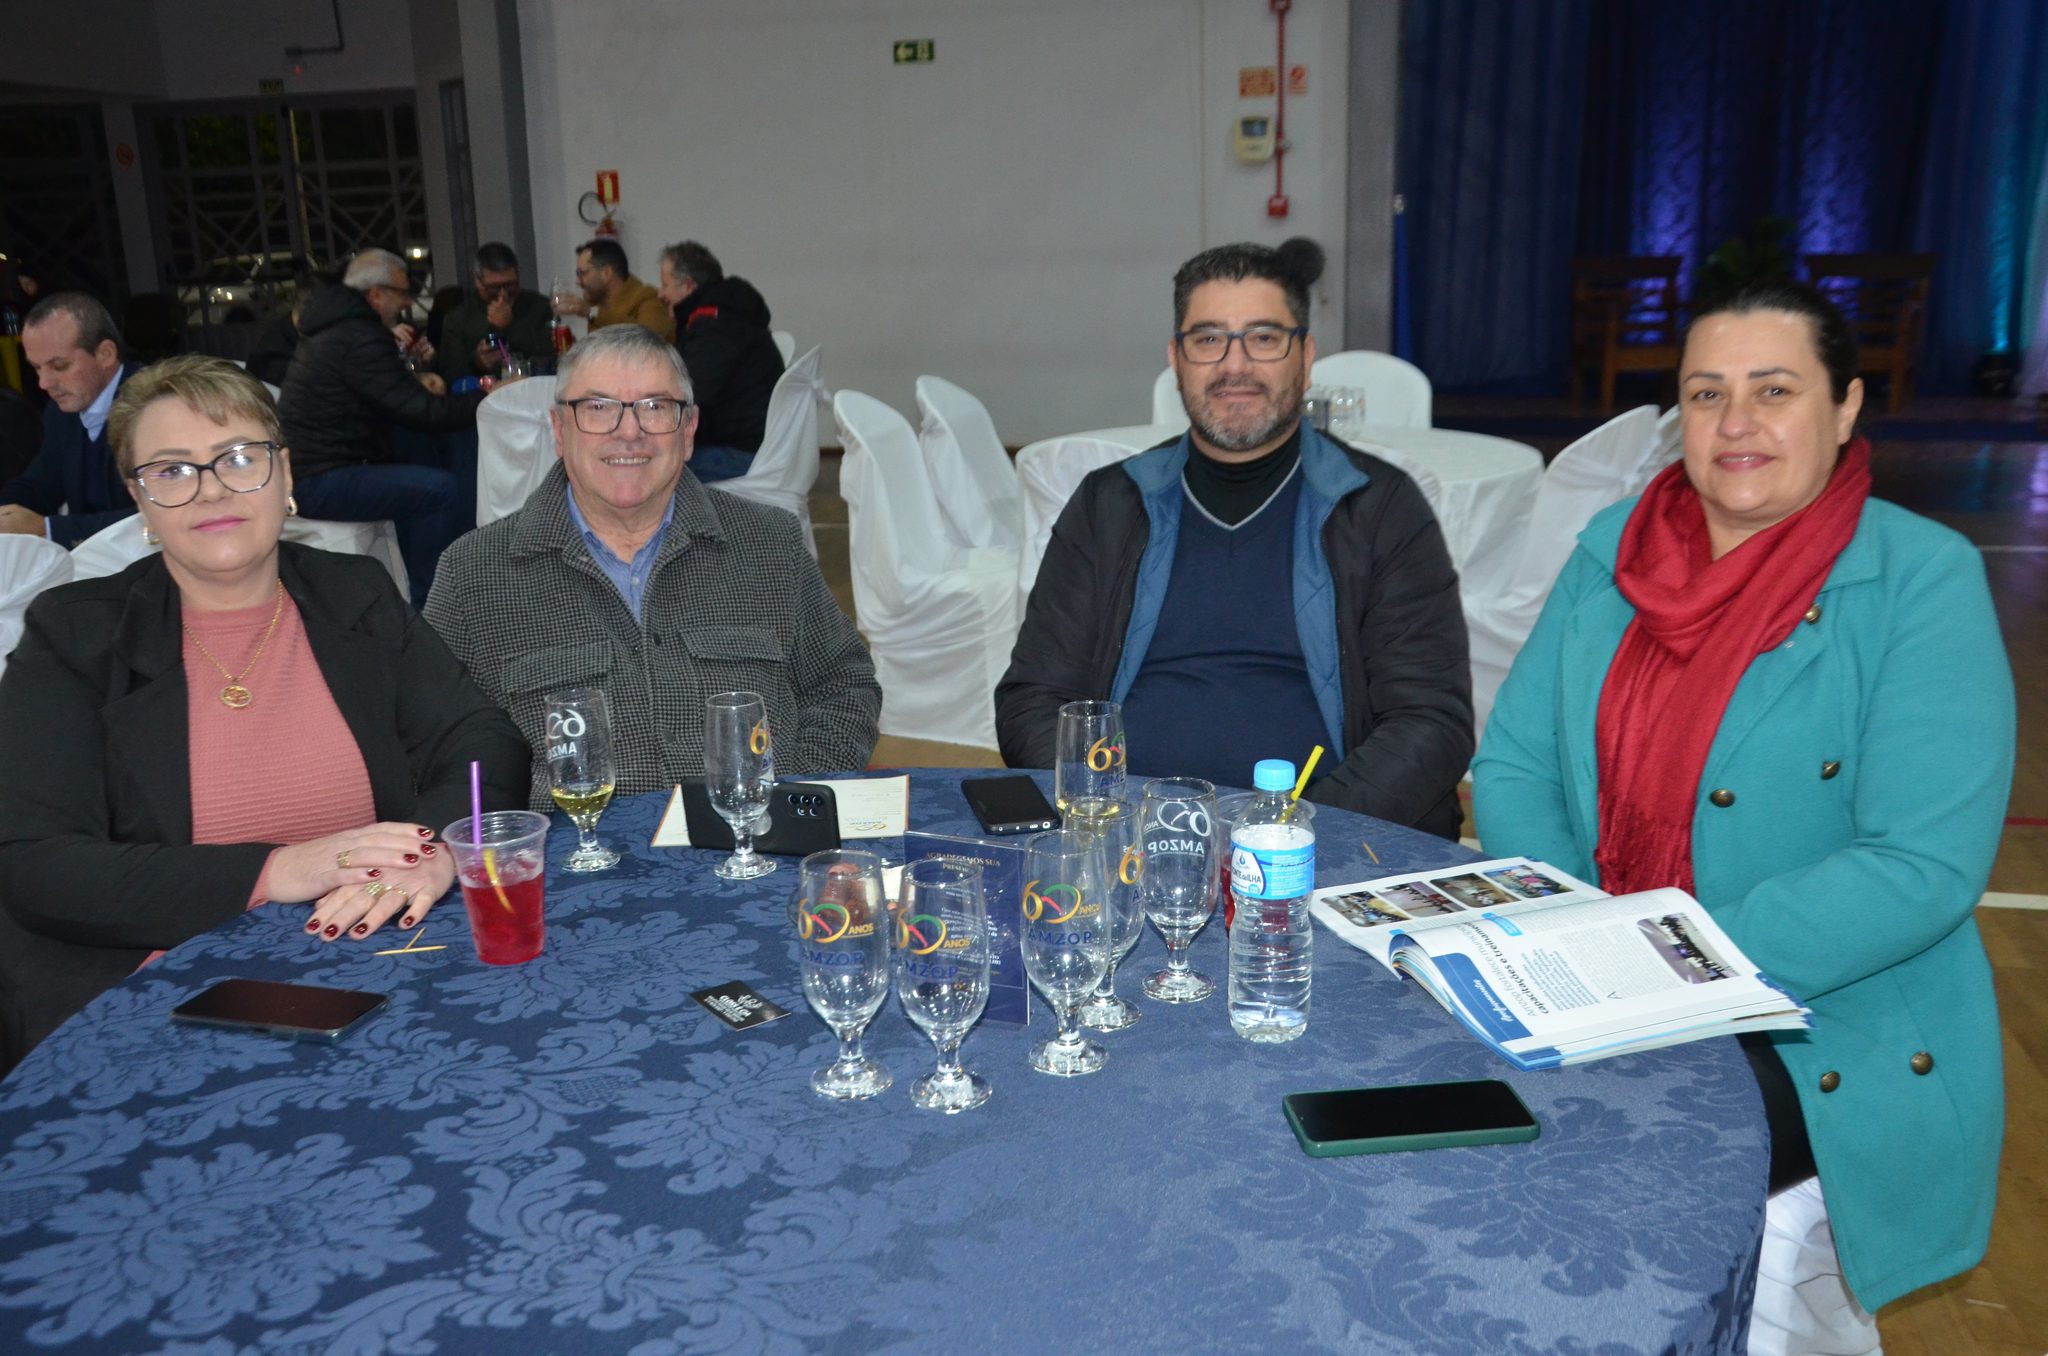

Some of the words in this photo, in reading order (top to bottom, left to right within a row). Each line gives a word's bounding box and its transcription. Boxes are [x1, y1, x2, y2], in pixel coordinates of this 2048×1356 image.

[1022, 880, 1081, 924] 60
[848, 923, 874, 936] ANOS
[1028, 928, 1092, 945] AMZOP
[943, 938, 971, 948] ANOS
